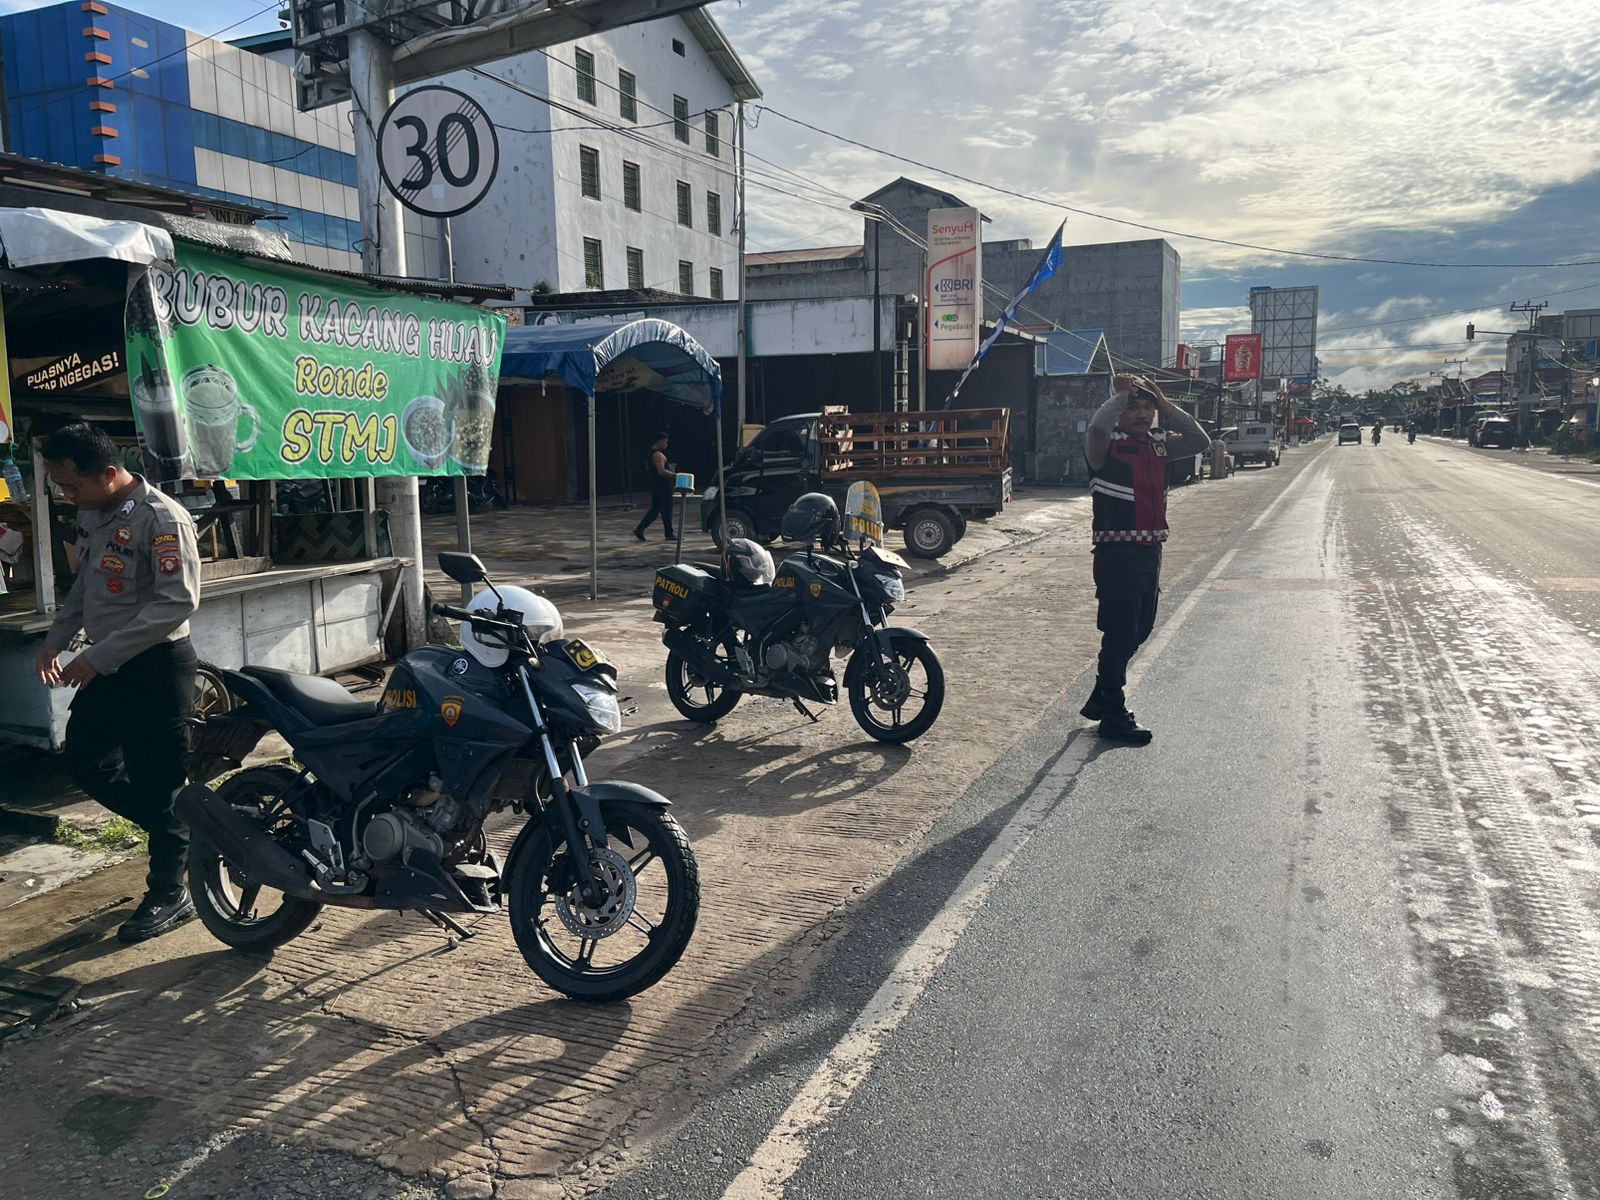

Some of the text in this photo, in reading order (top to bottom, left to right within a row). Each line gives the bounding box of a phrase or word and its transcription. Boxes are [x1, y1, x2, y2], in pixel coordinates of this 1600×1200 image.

[393, 112, 480, 190] 30
[954, 279, 973, 290] BRI
[151, 265, 498, 368] BUBUR KACANG HIJAU
[27, 352, 81, 386] PUASNYA
[60, 351, 120, 389] NGEGAS!
[295, 354, 389, 401] Ronde
[280, 408, 398, 465] STMJ
[655, 576, 688, 599] PATROLI
[773, 576, 795, 588] POLISI
[385, 689, 416, 708] POLISI
